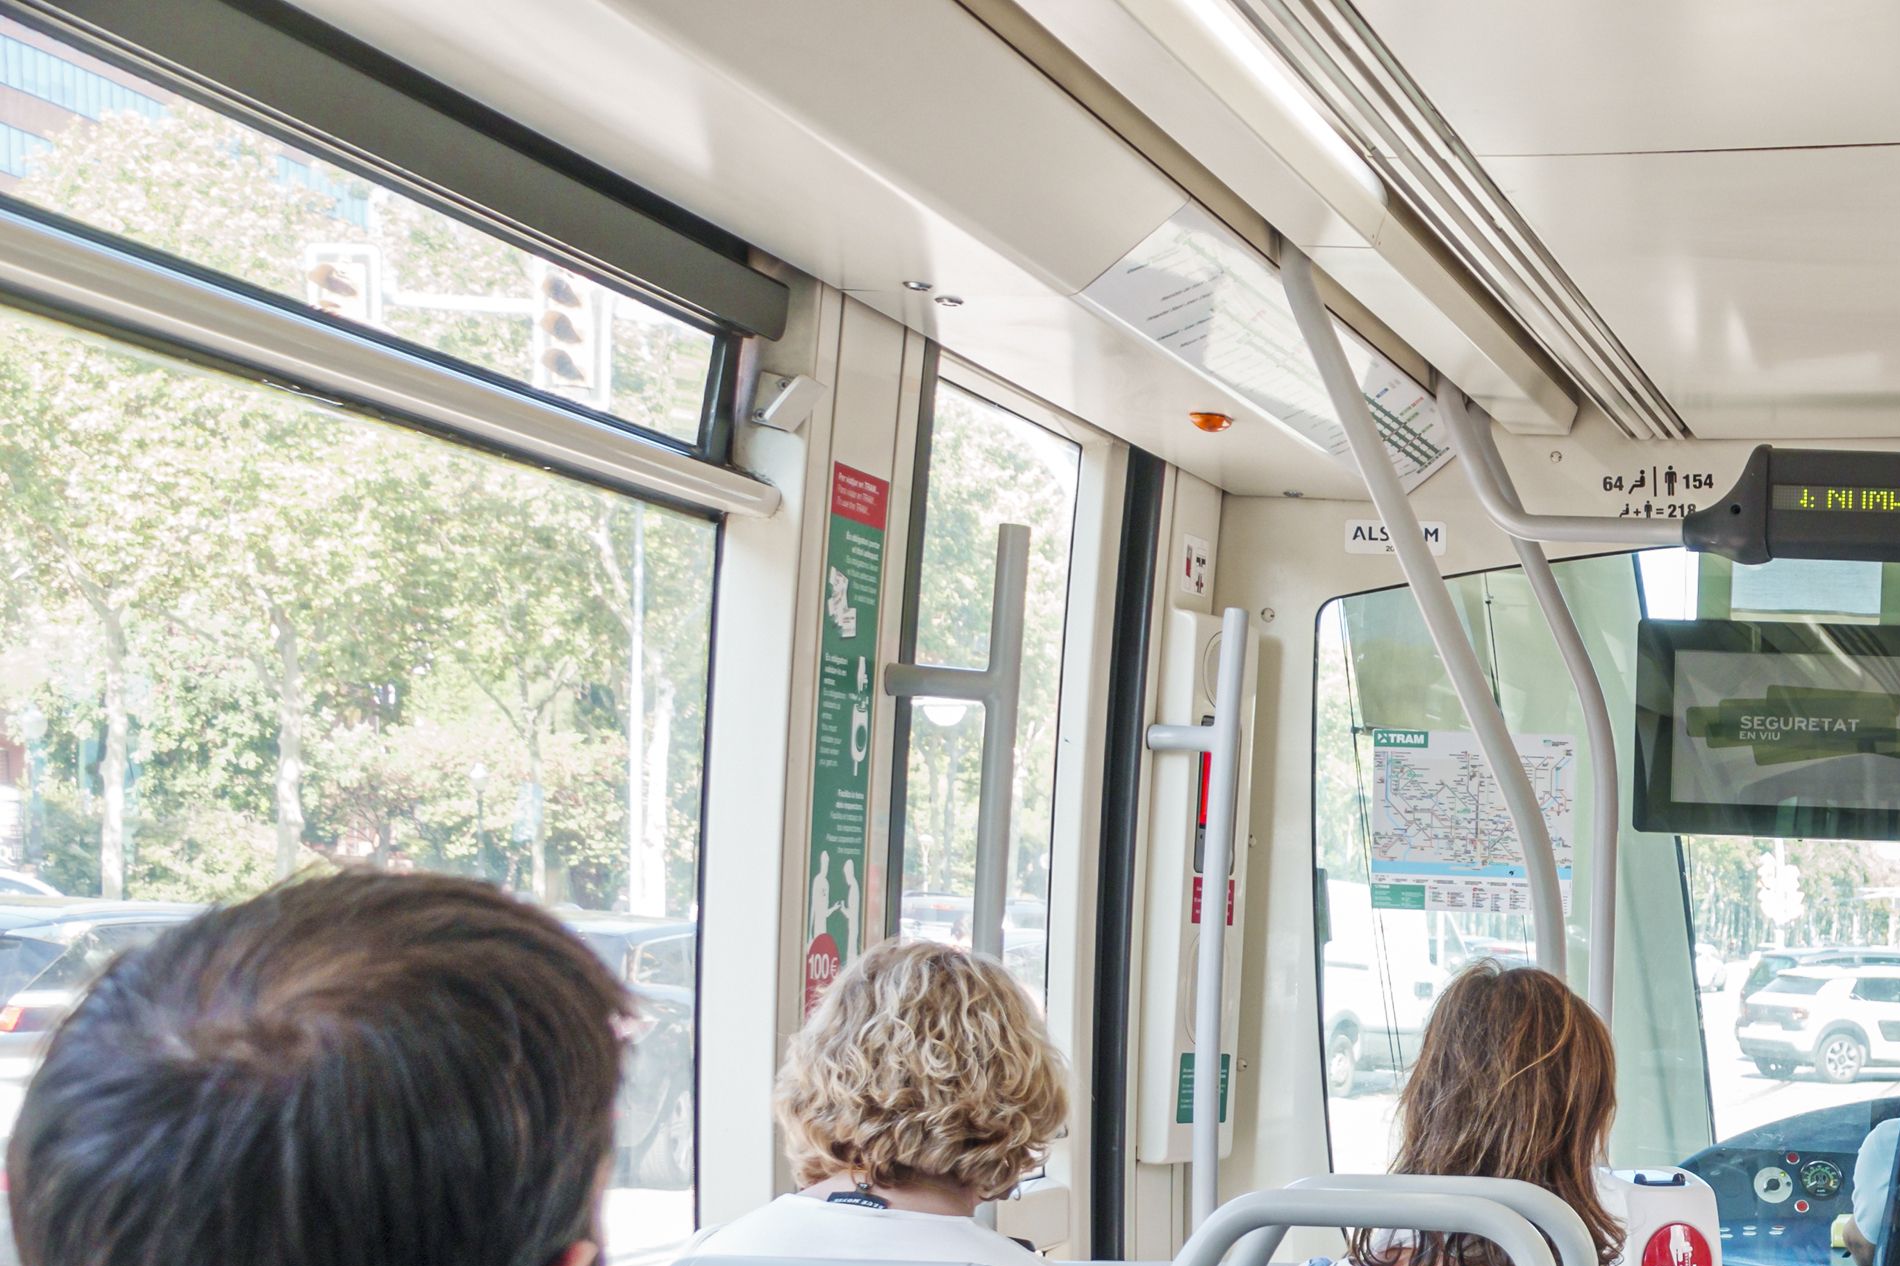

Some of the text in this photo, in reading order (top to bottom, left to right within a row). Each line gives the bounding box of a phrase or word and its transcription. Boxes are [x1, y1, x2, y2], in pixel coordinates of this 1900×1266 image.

[1602, 475, 1624, 492] 64
[1683, 473, 1714, 490] 154
[1667, 503, 1696, 518] 218
[1352, 526, 1439, 543] ALSM
[1739, 715, 1860, 733] SEGURETAT
[1388, 733, 1425, 745] TRAM
[1739, 731, 1781, 741] EN VIU
